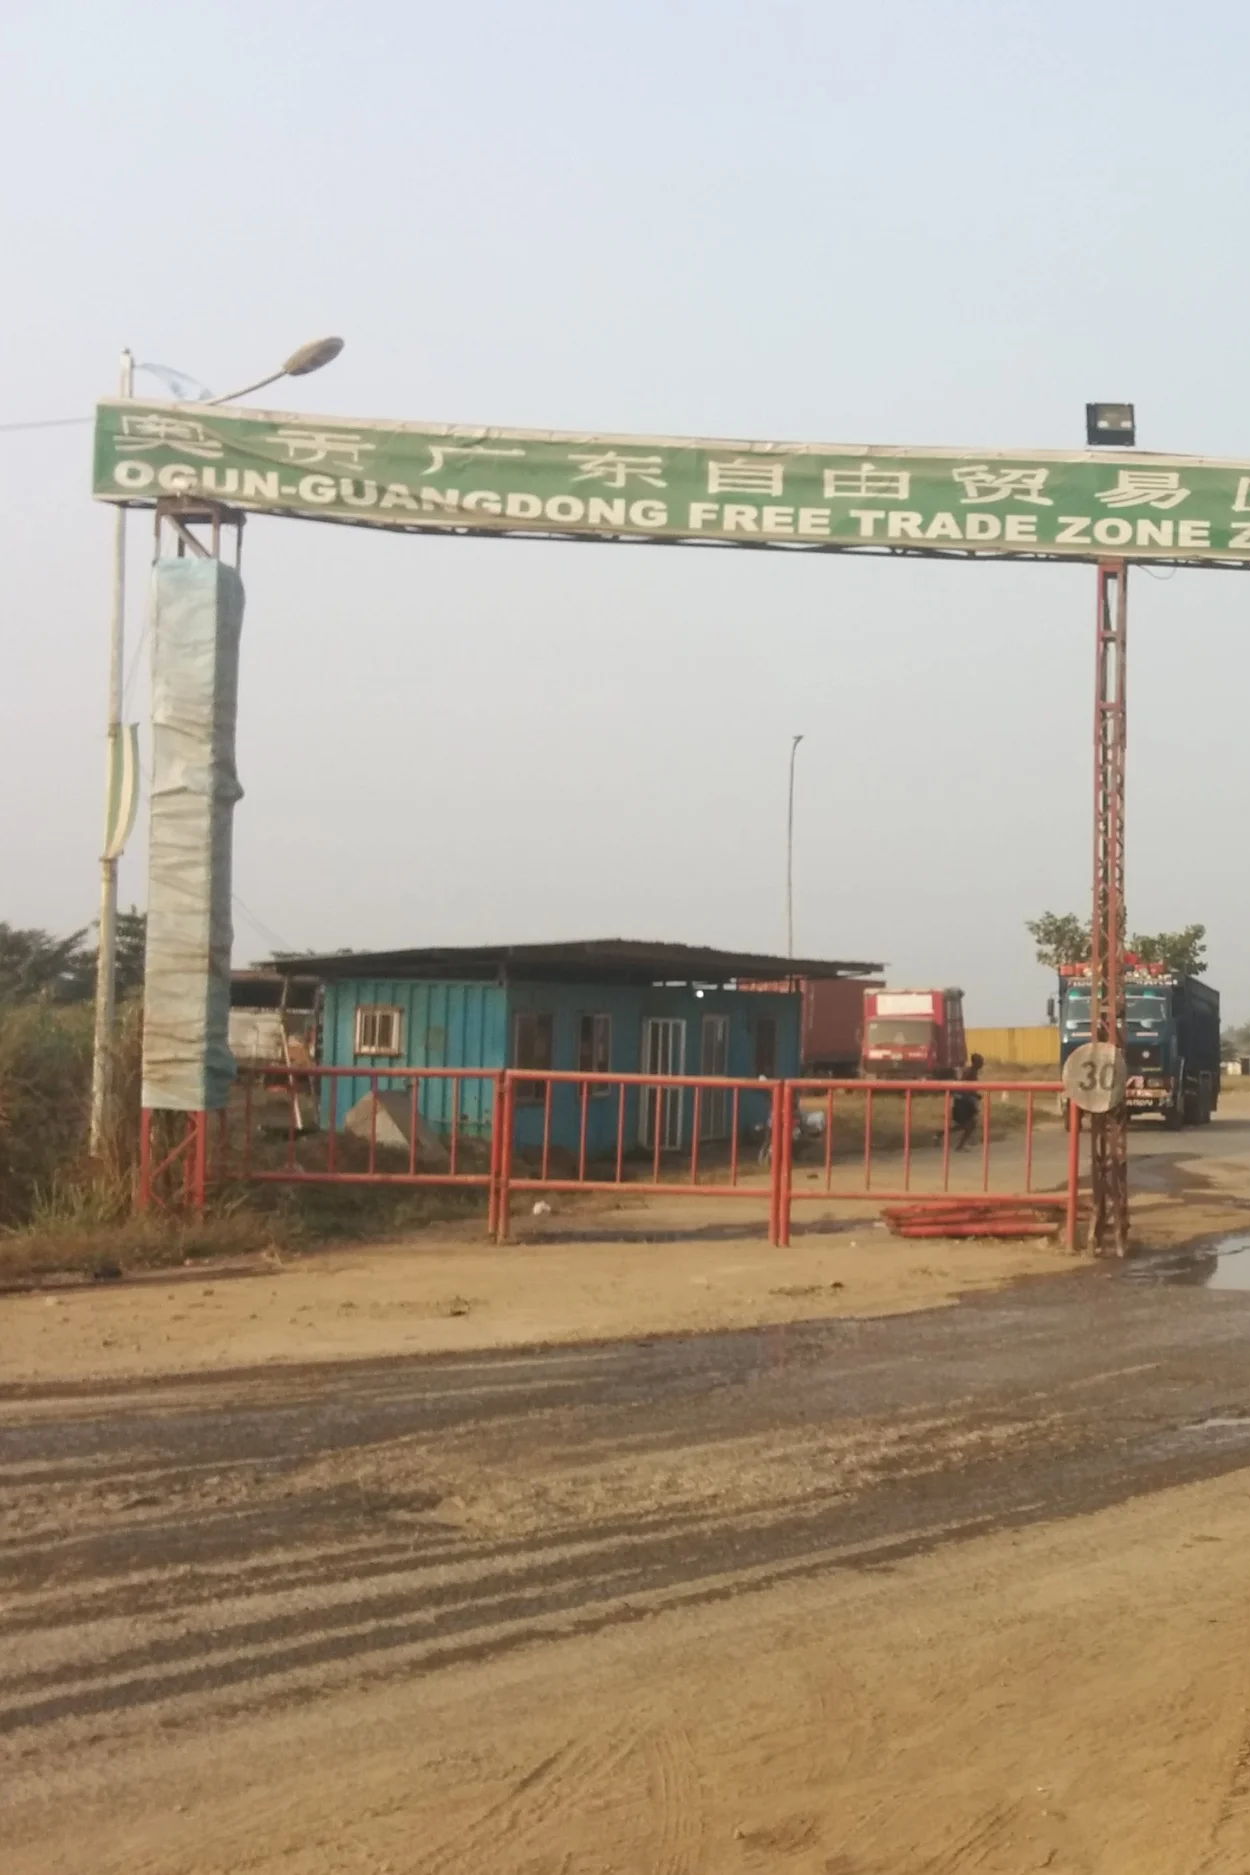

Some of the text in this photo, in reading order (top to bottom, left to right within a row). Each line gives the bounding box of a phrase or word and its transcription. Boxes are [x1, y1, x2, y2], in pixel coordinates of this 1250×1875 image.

[113, 459, 668, 528] OGUN-GUANGDONG
[688, 502, 832, 537] FREE
[848, 508, 1038, 543] TRADE
[1054, 514, 1212, 549] ZONE
[1078, 1061, 1116, 1091] 30
